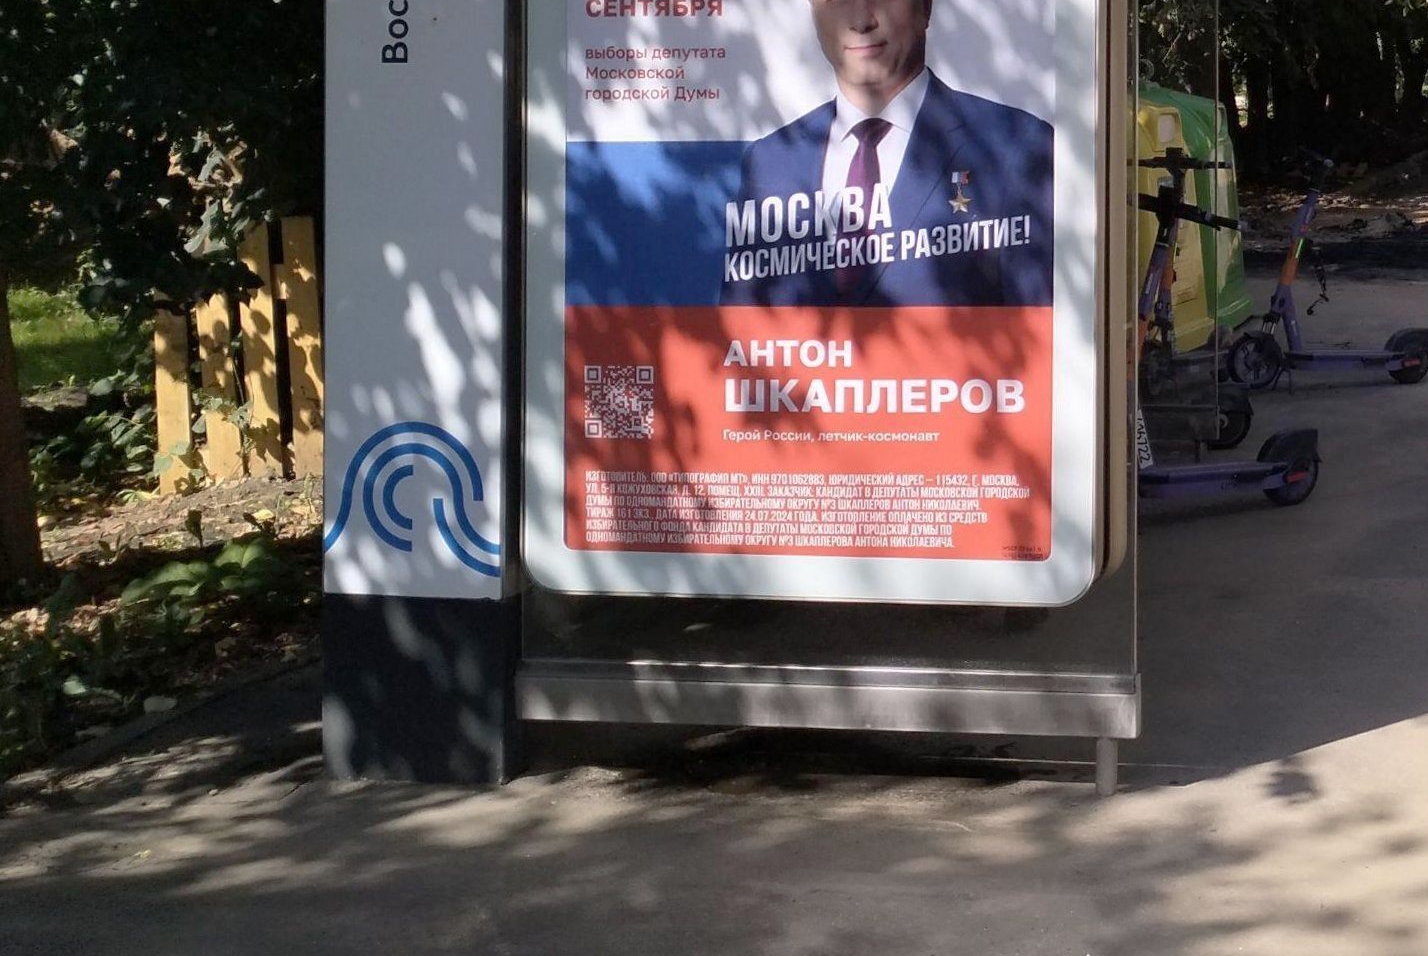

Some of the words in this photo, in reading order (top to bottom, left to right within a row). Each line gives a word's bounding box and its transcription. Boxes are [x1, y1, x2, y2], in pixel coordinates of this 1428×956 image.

[585, 45, 647, 61] выборы
[651, 45, 727, 62] депутата
[585, 64, 685, 80] Московской
[585, 84, 670, 101] городской
[674, 86, 720, 103] Думы
[725, 182, 892, 247] МОСКВА
[724, 230, 895, 283] КОСМИЧЕСКОЕ
[901, 214, 1031, 262] РАЗВИТИЕ!
[724, 339, 854, 368] АНТОН
[724, 378, 1027, 414] ШКАПЛЕРОВ
[722, 428, 761, 441] Герой
[764, 429, 815, 443] России,
[818, 431, 940, 442] летчик-космонавт
[896, 474, 924, 486] АДРЕС
[816, 485, 863, 497] КАНДИДАТ
[872, 486, 919, 498] ДЕПУТАТЫ
[752, 521, 798, 533] ДЕПУТАТЫ
